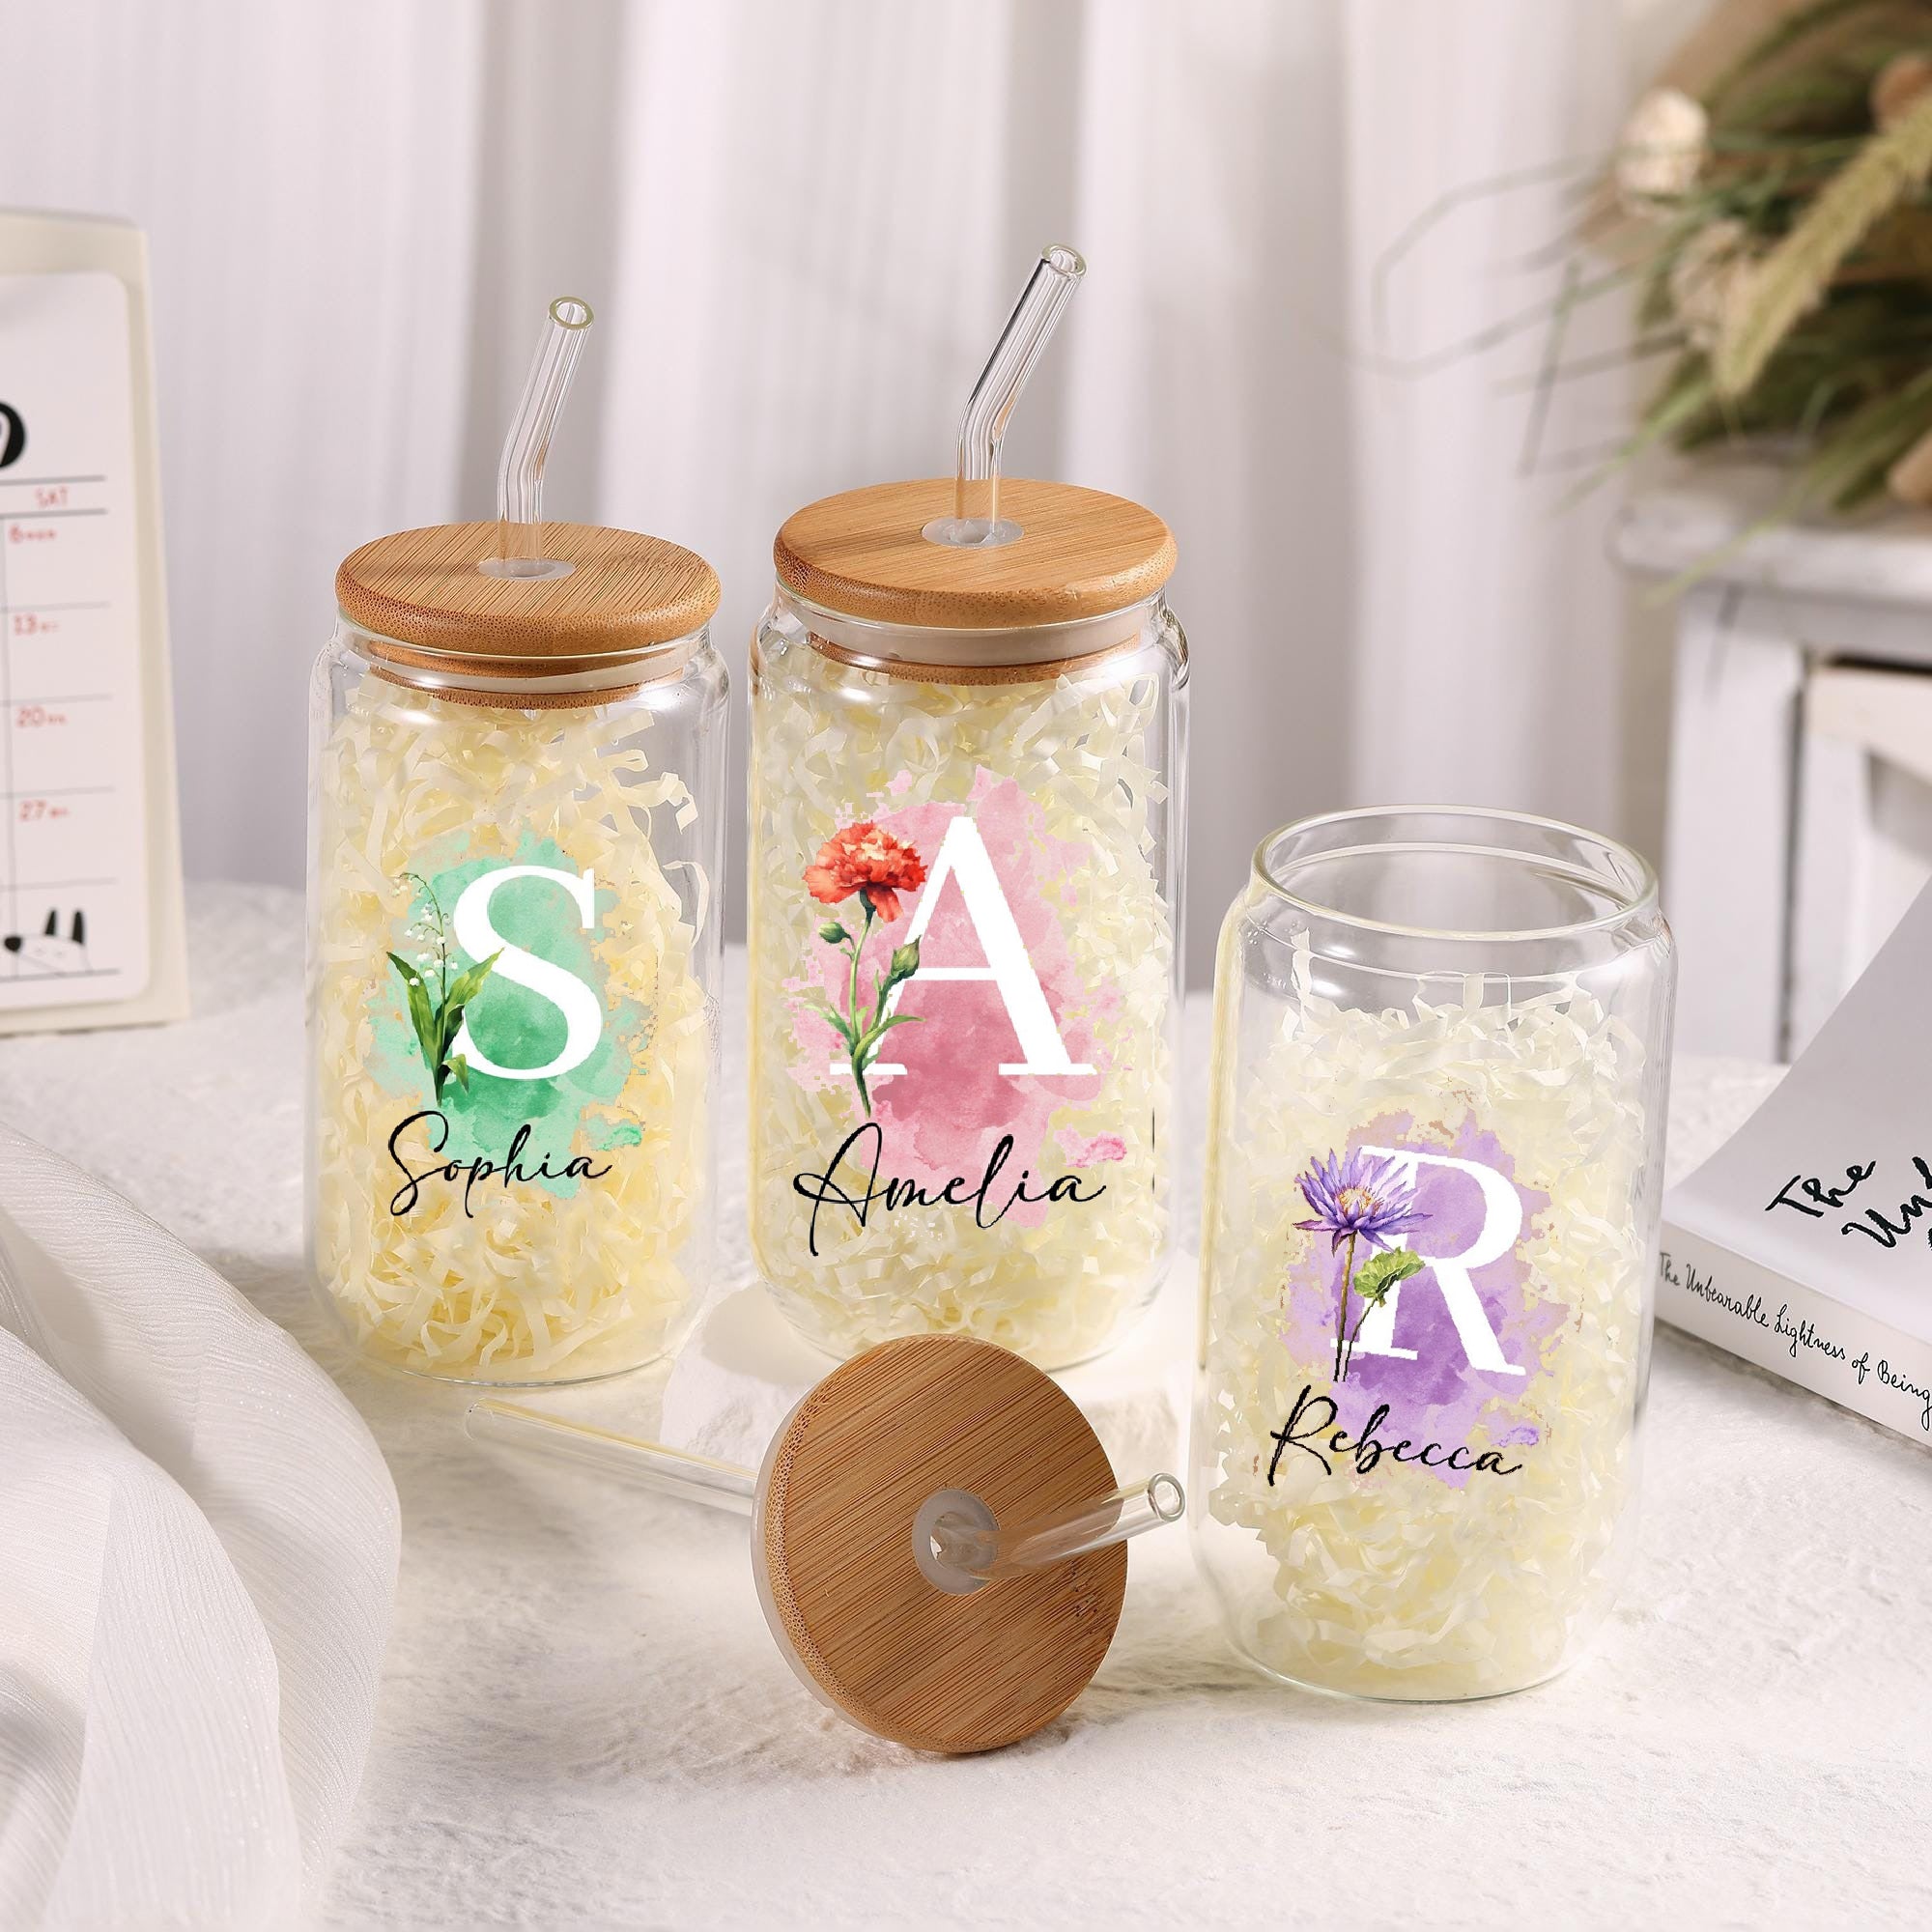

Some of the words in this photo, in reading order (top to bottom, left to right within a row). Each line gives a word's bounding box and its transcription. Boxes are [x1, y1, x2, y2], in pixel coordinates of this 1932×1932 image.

[35, 486, 69, 507] SAT
[17, 706, 46, 727] 20
[19, 800, 46, 820] 27
[452, 865, 603, 1080] S
[829, 816, 1098, 1075] A
[387, 1110, 613, 1218] Sophia
[792, 1122, 1107, 1257] Amelia
[1765, 1160, 1877, 1218] The
[1330, 1145, 1526, 1376] R
[1659, 1251, 1681, 1287] The
[1686, 1263, 1770, 1328] Unbearable
[1774, 1303, 1846, 1359] Lightness
[1851, 1351, 1871, 1385] of
[1877, 1359, 1932, 1432] Being
[1266, 1384, 1523, 1487] Rebecca
